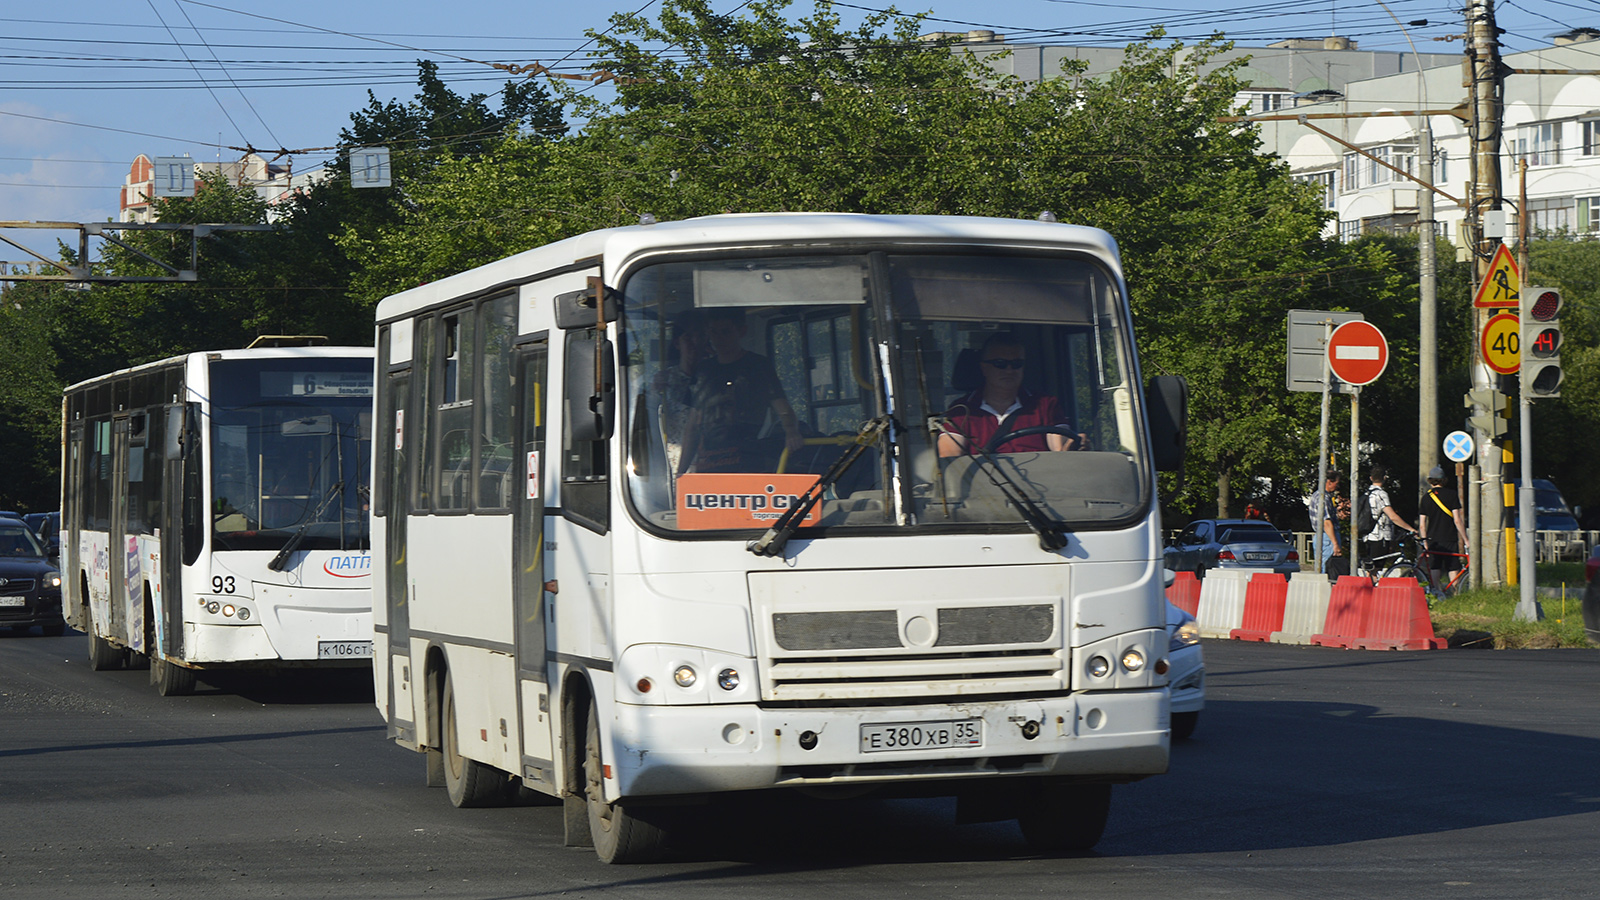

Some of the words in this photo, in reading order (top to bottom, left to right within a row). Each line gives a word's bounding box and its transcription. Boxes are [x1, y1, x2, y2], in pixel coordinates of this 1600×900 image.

[1492, 332, 1520, 354] 40
[303, 374, 316, 394] 6
[686, 494, 767, 511] центр
[212, 576, 236, 594] 93
[955, 723, 975, 738] 35
